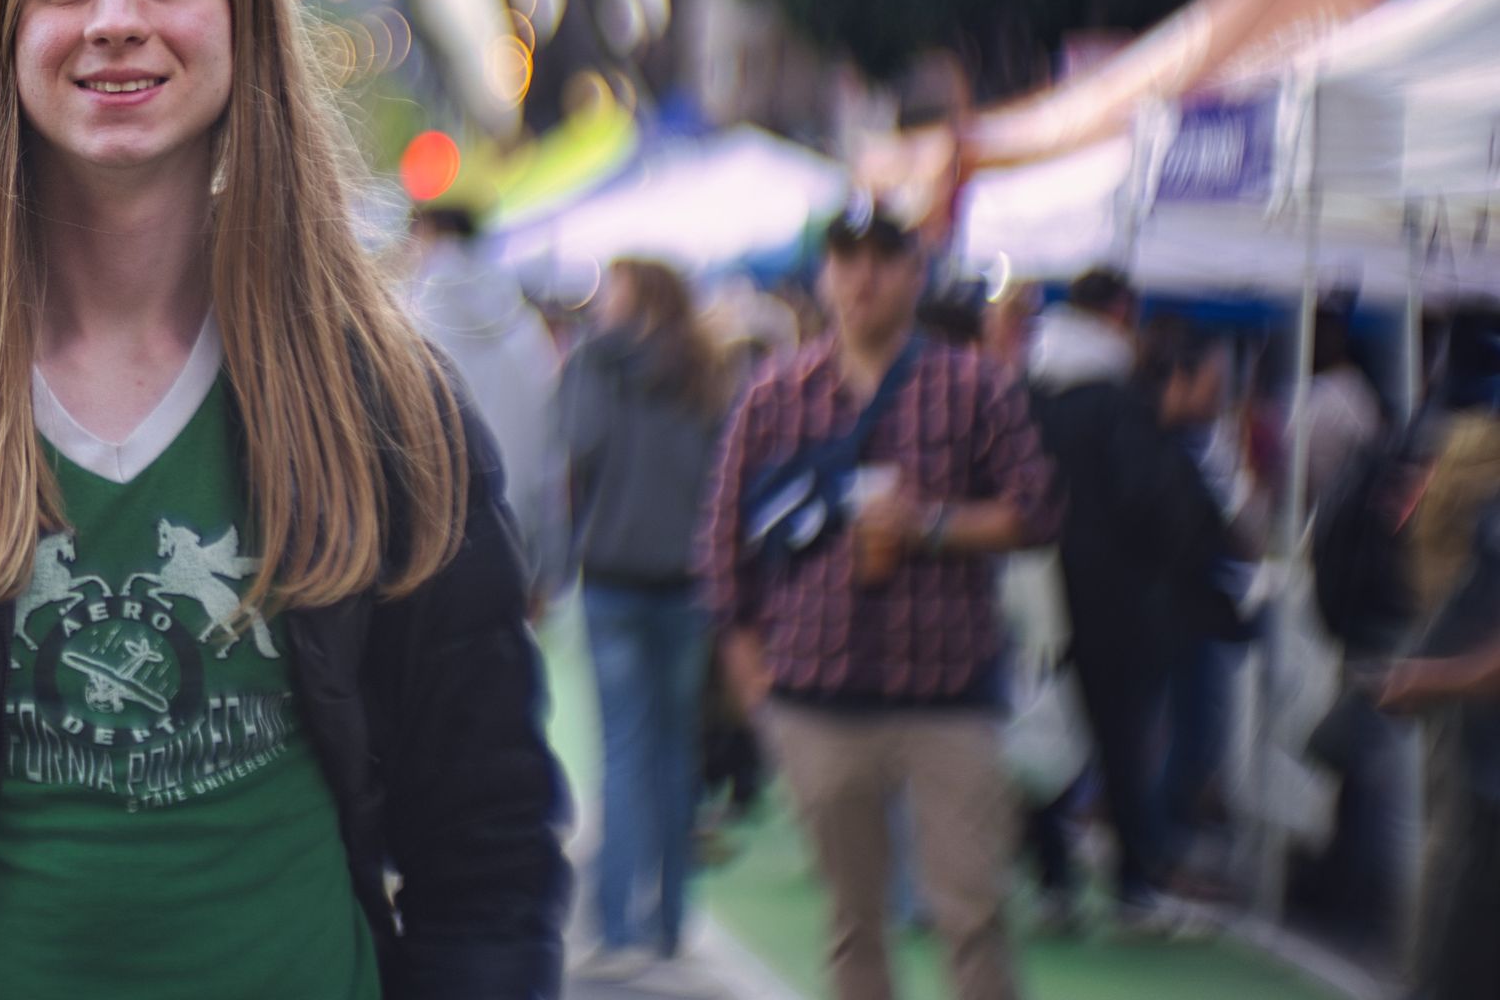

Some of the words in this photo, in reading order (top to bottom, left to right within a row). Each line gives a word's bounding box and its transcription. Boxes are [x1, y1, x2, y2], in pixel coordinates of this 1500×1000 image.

[63, 601, 172, 637] AERO
[127, 789, 187, 813] STATE
[193, 743, 287, 794] UNIVERSITY
